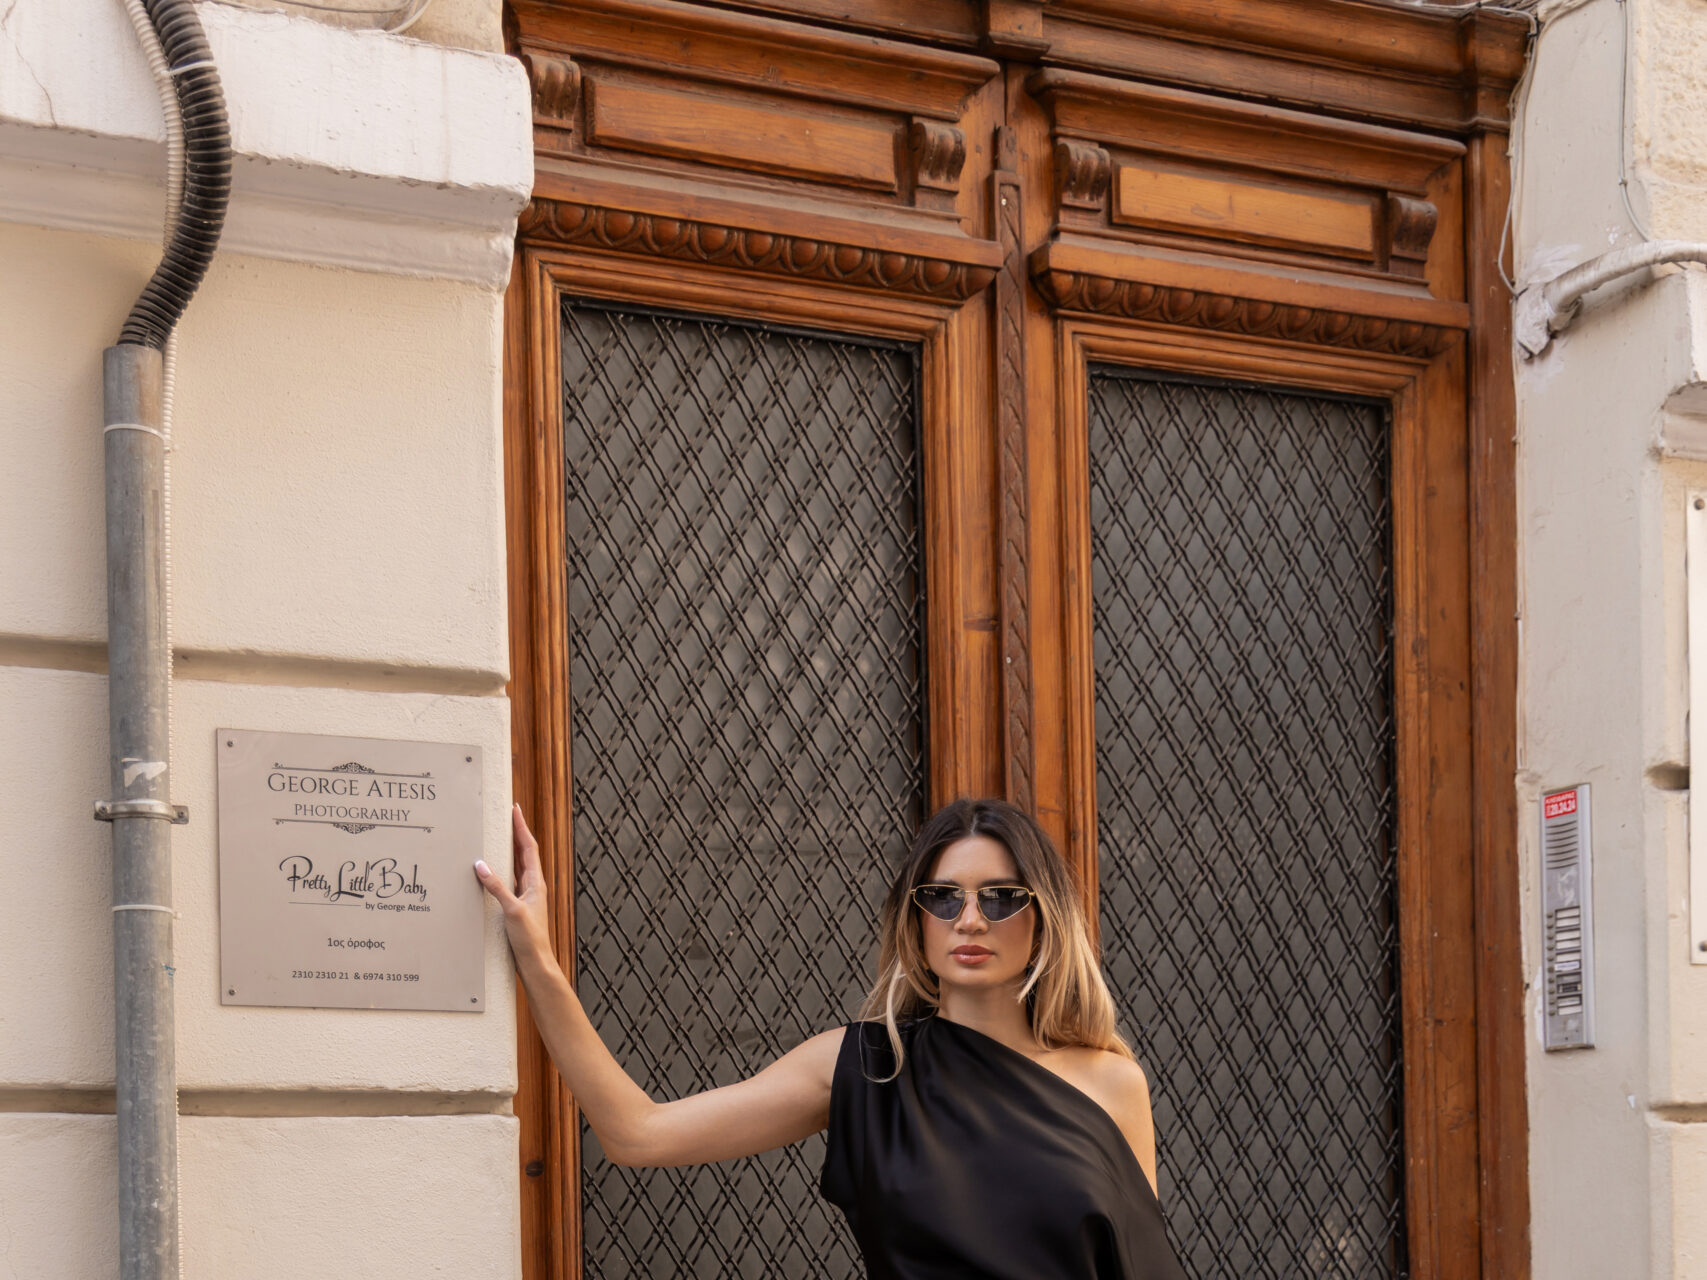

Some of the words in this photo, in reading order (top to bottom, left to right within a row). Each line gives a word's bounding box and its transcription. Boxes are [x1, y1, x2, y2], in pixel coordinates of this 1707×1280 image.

[267, 772, 360, 796] GEORGE
[367, 779, 437, 801] ATESIS
[279, 855, 332, 898] Pretty
[329, 860, 374, 903] Little
[370, 858, 427, 902] Baby
[365, 902, 375, 911] by
[377, 902, 406, 913] George
[407, 903, 431, 912] Atesis
[327, 937, 345, 949] 1ος
[347, 938, 385, 950] όροφος
[292, 970, 314, 979] 2310
[315, 971, 337, 980] 2310
[338, 971, 349, 980] 21
[353, 972, 360, 980] &
[363, 972, 384, 981] 6974
[386, 973, 402, 982] 310
[403, 974, 419, 982] 599
